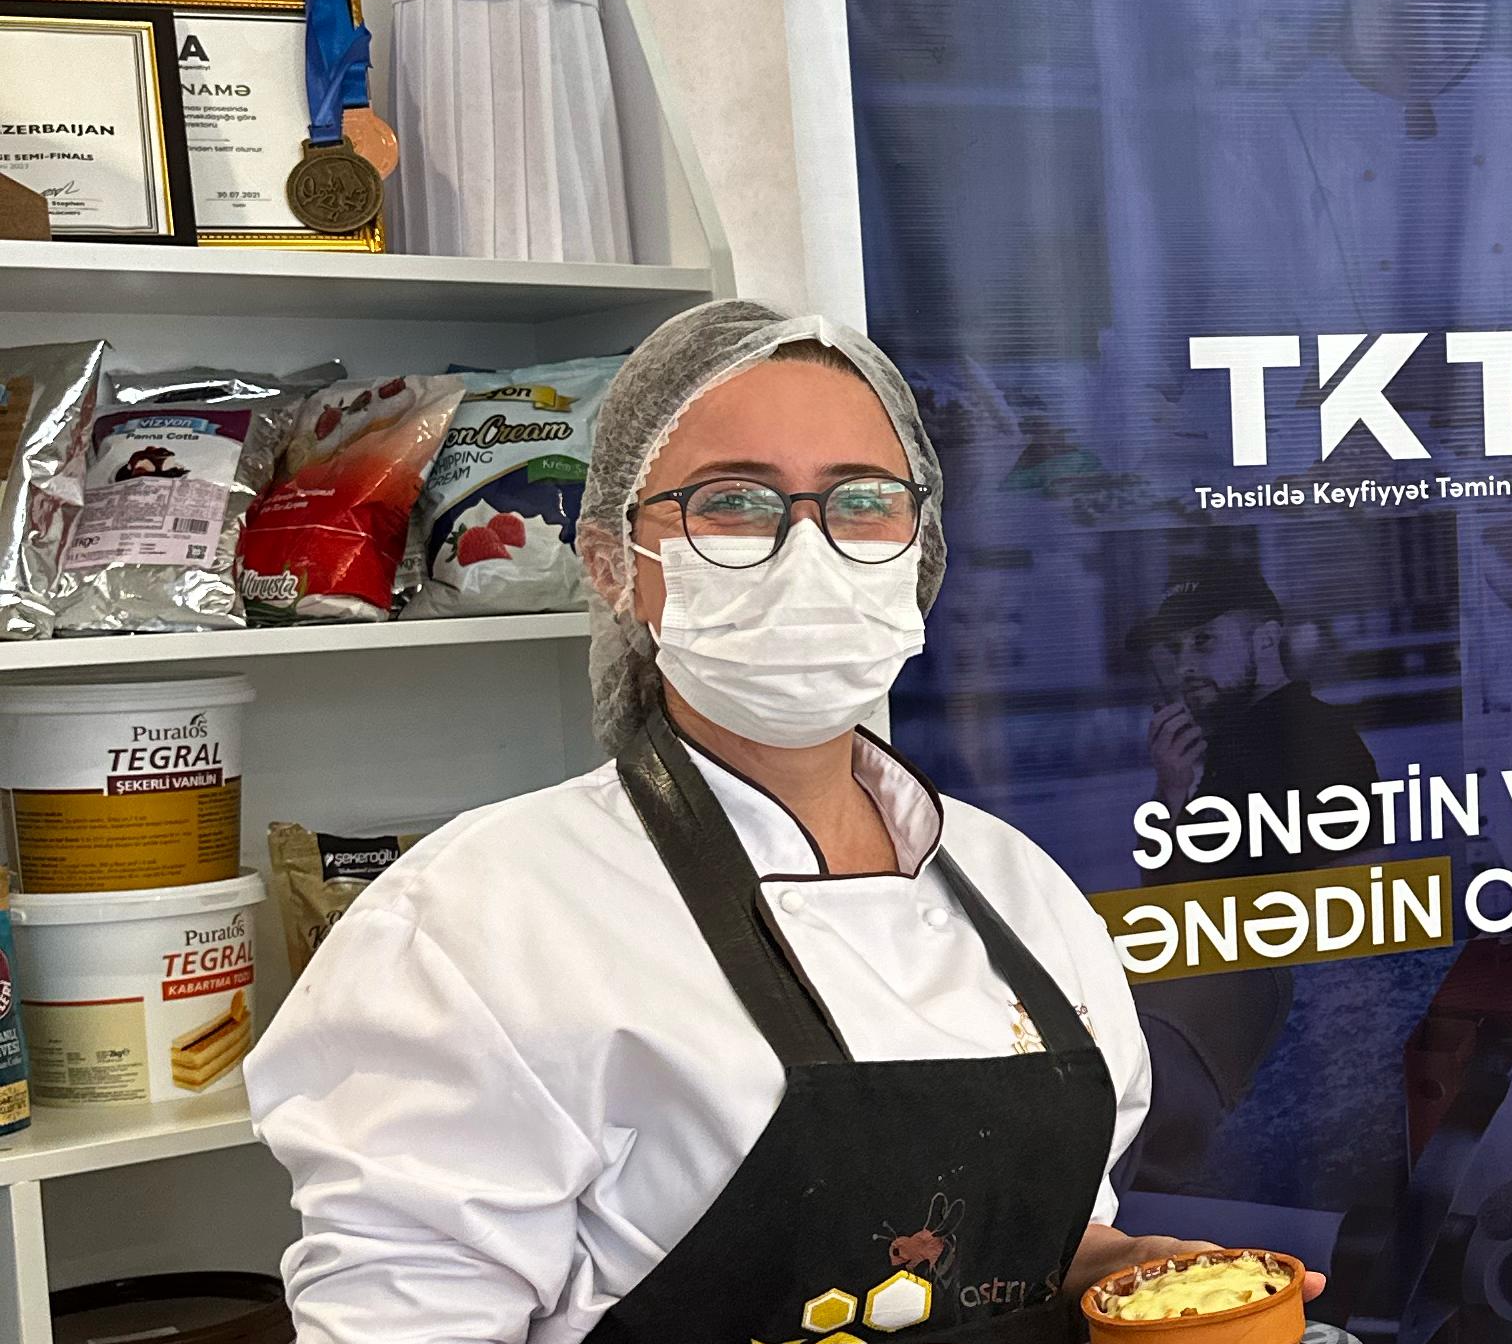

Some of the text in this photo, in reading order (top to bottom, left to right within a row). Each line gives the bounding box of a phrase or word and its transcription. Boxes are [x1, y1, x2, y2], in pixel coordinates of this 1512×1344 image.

[14, 152, 94, 161] SEMI-FINALS
[140, 417, 193, 428] vizyon
[126, 432, 200, 441] Panna Cotta
[1195, 483, 1305, 509] Təhsildə
[1313, 478, 1430, 507] Keyfiyyət
[132, 723, 208, 742] Puratos
[107, 743, 223, 773] TEGRAL
[116, 774, 170, 795] ŞEKERLİ
[1132, 763, 1480, 870] SƏNƏTİN
[184, 920, 245, 946] Puratos
[162, 939, 254, 977] TEGRAL
[168, 974, 232, 997] KABARTMA
